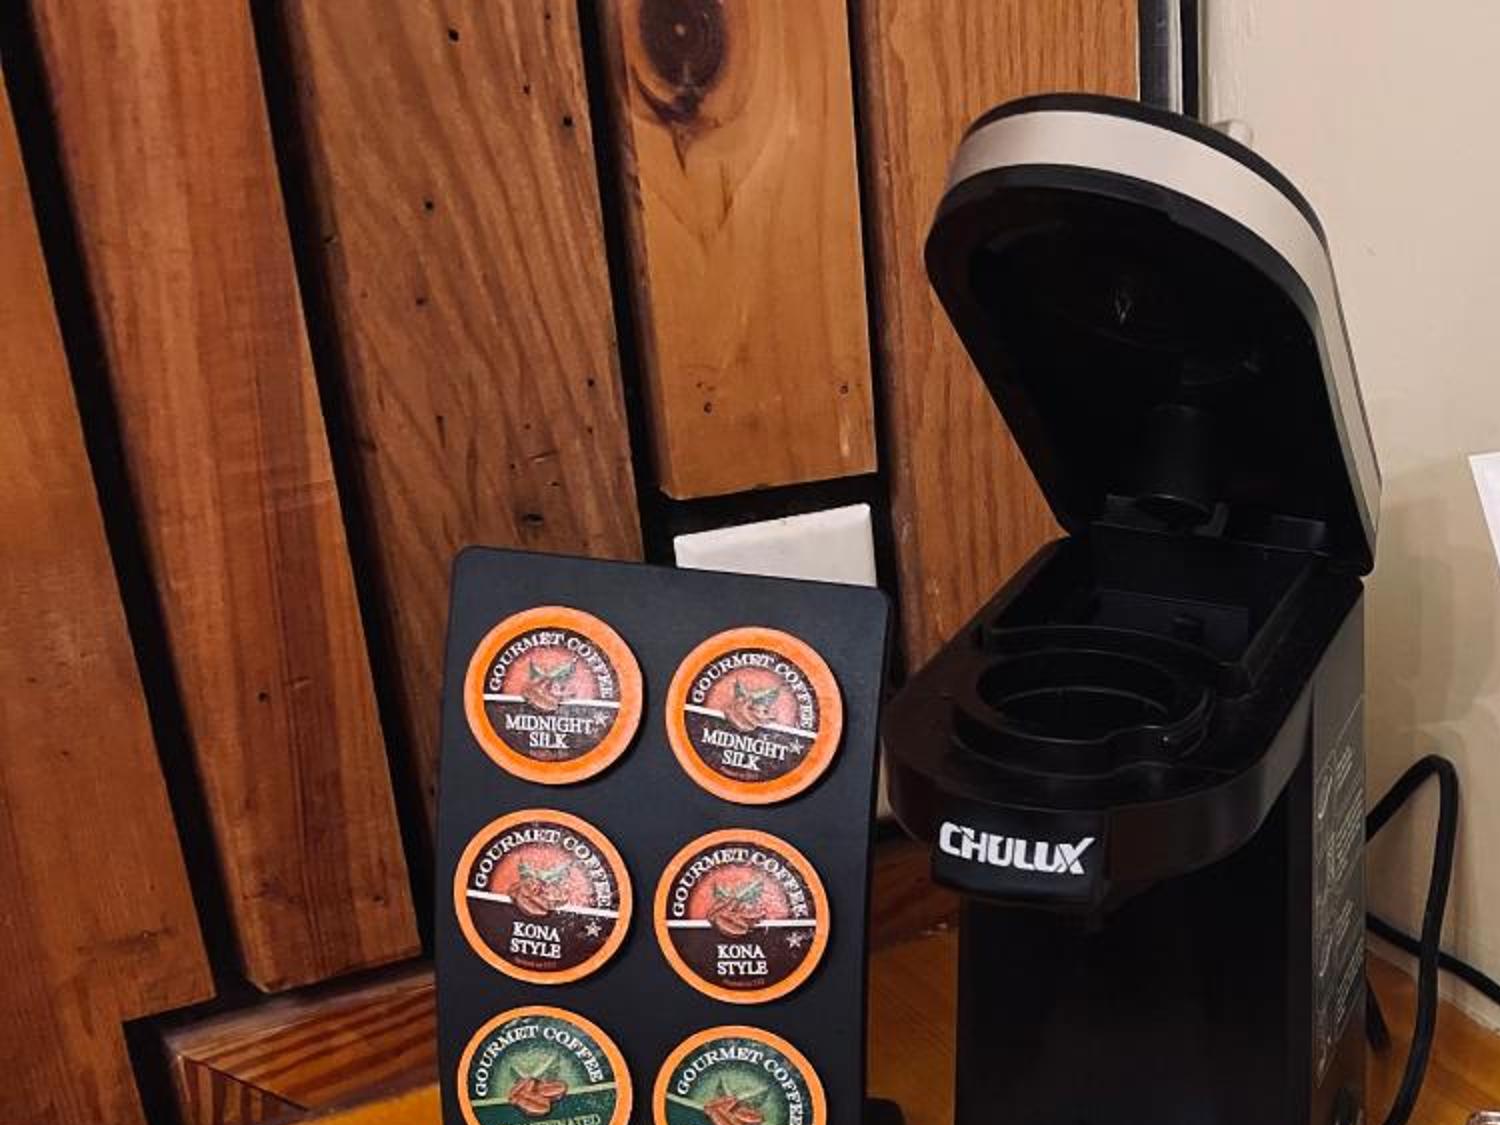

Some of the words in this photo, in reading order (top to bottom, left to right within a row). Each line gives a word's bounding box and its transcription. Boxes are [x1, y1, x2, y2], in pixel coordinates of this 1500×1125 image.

[489, 632, 564, 692] GOURMET
[567, 637, 613, 699] COFFEE
[692, 653, 775, 703] GOURMET
[775, 662, 813, 729] COFFEE
[505, 713, 594, 735] MIDNIGHT
[529, 731, 569, 749] SILK
[701, 728, 789, 761] MIDNIGHT
[721, 749, 761, 771] SILK
[939, 821, 1096, 875] CHULUX
[475, 829, 561, 888] GOURMET
[563, 836, 612, 908] COFFEE
[672, 848, 749, 917] GOURMET
[751, 852, 809, 918] COFFEE
[510, 938, 562, 959] STYLE
[512, 921, 561, 943] KONA
[717, 944, 766, 959] KONA
[717, 960, 768, 975] STYLE
[475, 1025, 539, 1097] GOURMET
[543, 1027, 604, 1083] COFFEE
[677, 1048, 764, 1095] GOURMET
